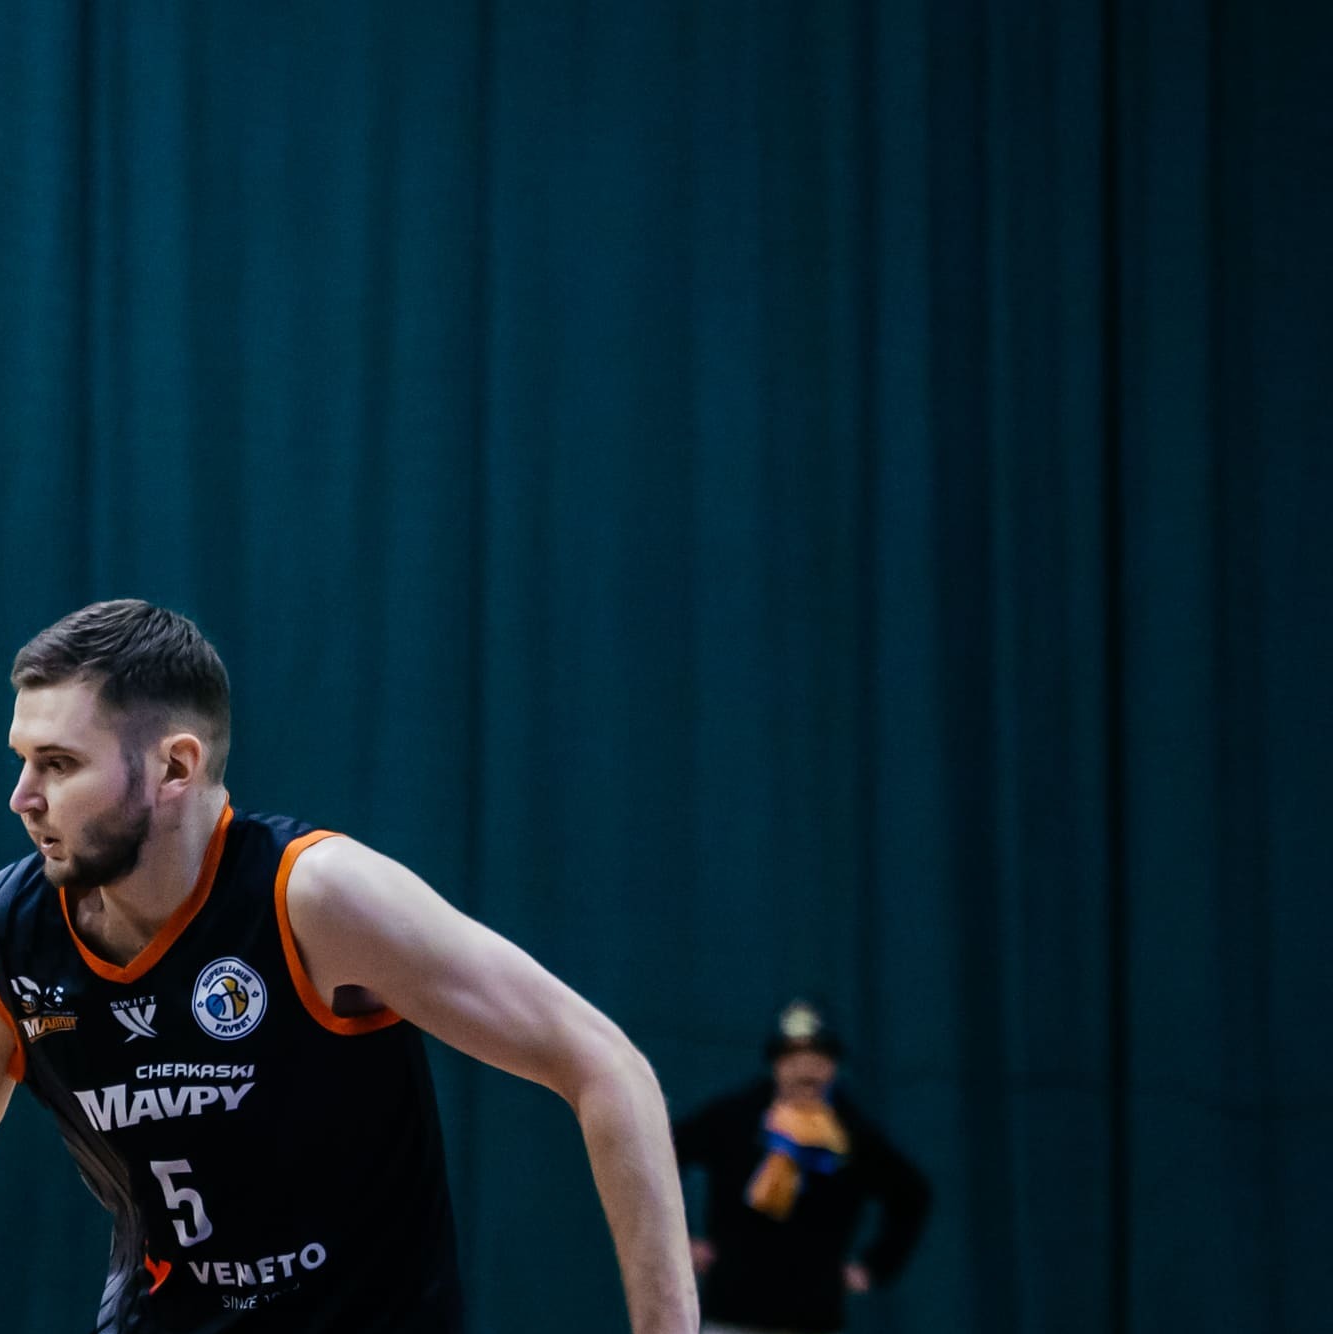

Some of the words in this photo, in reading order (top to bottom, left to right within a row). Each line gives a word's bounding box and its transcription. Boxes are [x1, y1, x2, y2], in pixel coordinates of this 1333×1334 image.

[110, 995, 157, 1011] SWIFT
[214, 1014, 253, 1034] FAVBET
[135, 1063, 255, 1080] CHERKASKI
[73, 1082, 256, 1132] MAVPY
[149, 1158, 213, 1248] 5
[187, 1242, 327, 1288] VENETO
